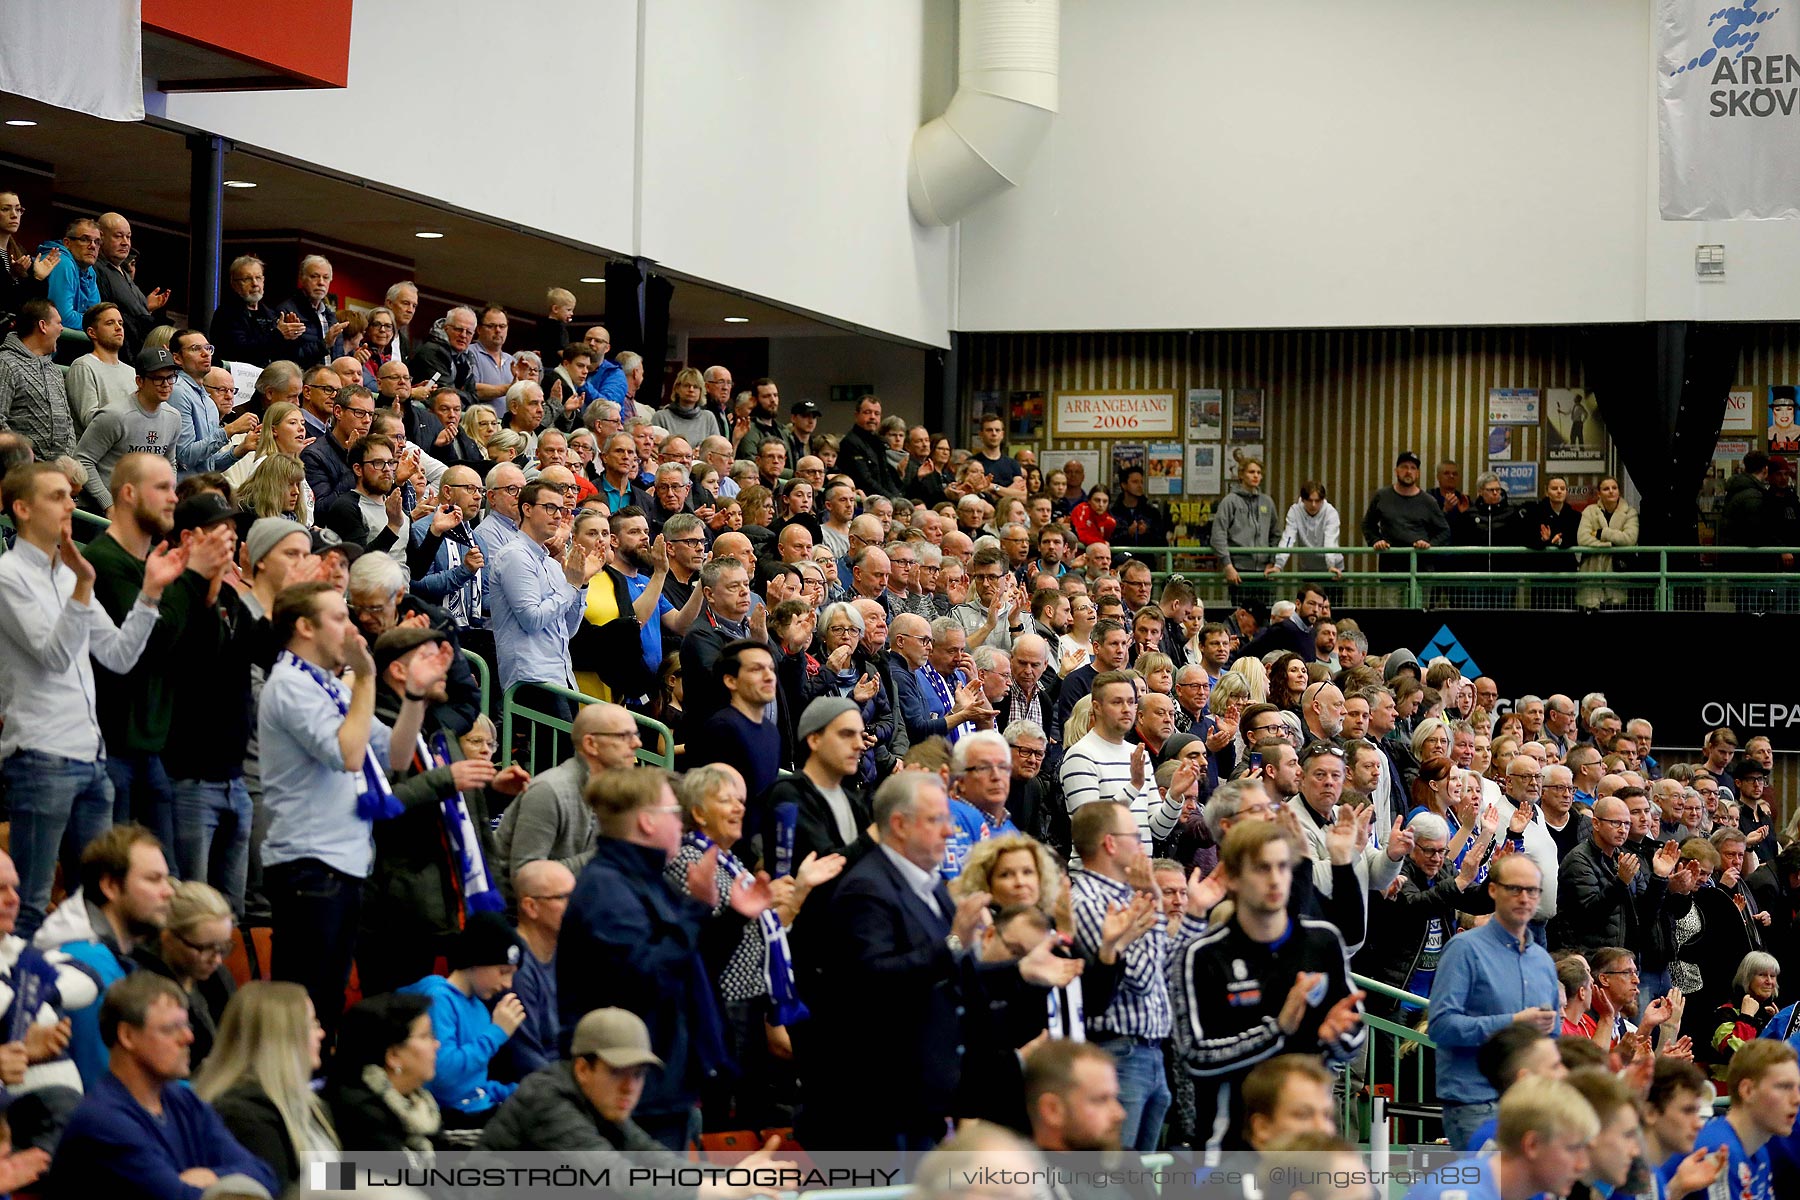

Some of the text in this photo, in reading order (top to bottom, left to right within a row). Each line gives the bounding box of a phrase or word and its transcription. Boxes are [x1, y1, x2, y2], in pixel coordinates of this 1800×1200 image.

[1709, 88, 1800, 117] SKÖV
[158, 350, 167, 362] P
[1064, 398, 1167, 413] ARRANGEMANG
[1092, 414, 1139, 429] 2006
[1549, 449, 1577, 458] BJÖRN
[1510, 467, 1533, 478] 2007
[1701, 701, 1800, 728] ONEPA
